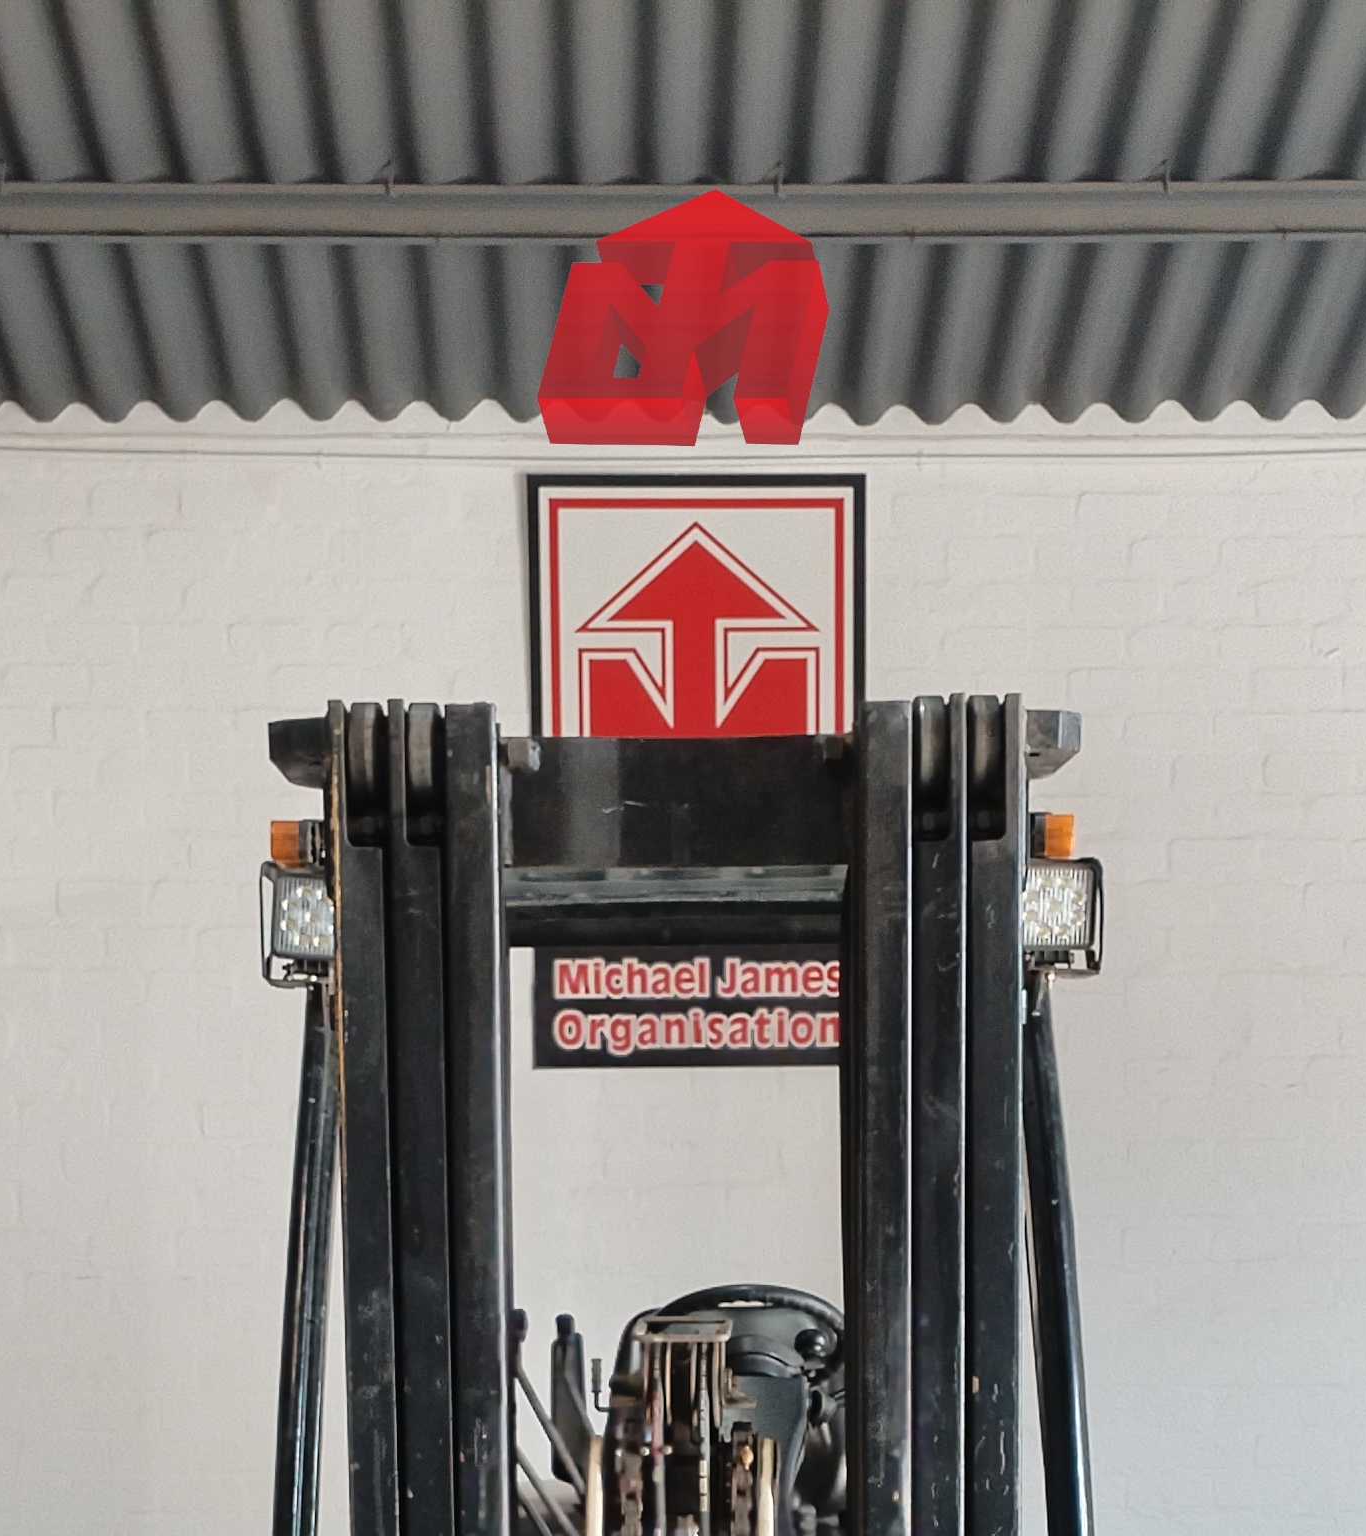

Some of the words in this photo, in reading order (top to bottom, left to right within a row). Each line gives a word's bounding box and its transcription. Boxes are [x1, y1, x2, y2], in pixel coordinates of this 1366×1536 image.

[553, 956, 710, 999] Michael
[717, 956, 839, 997] James
[553, 1007, 839, 1055] Organisation
